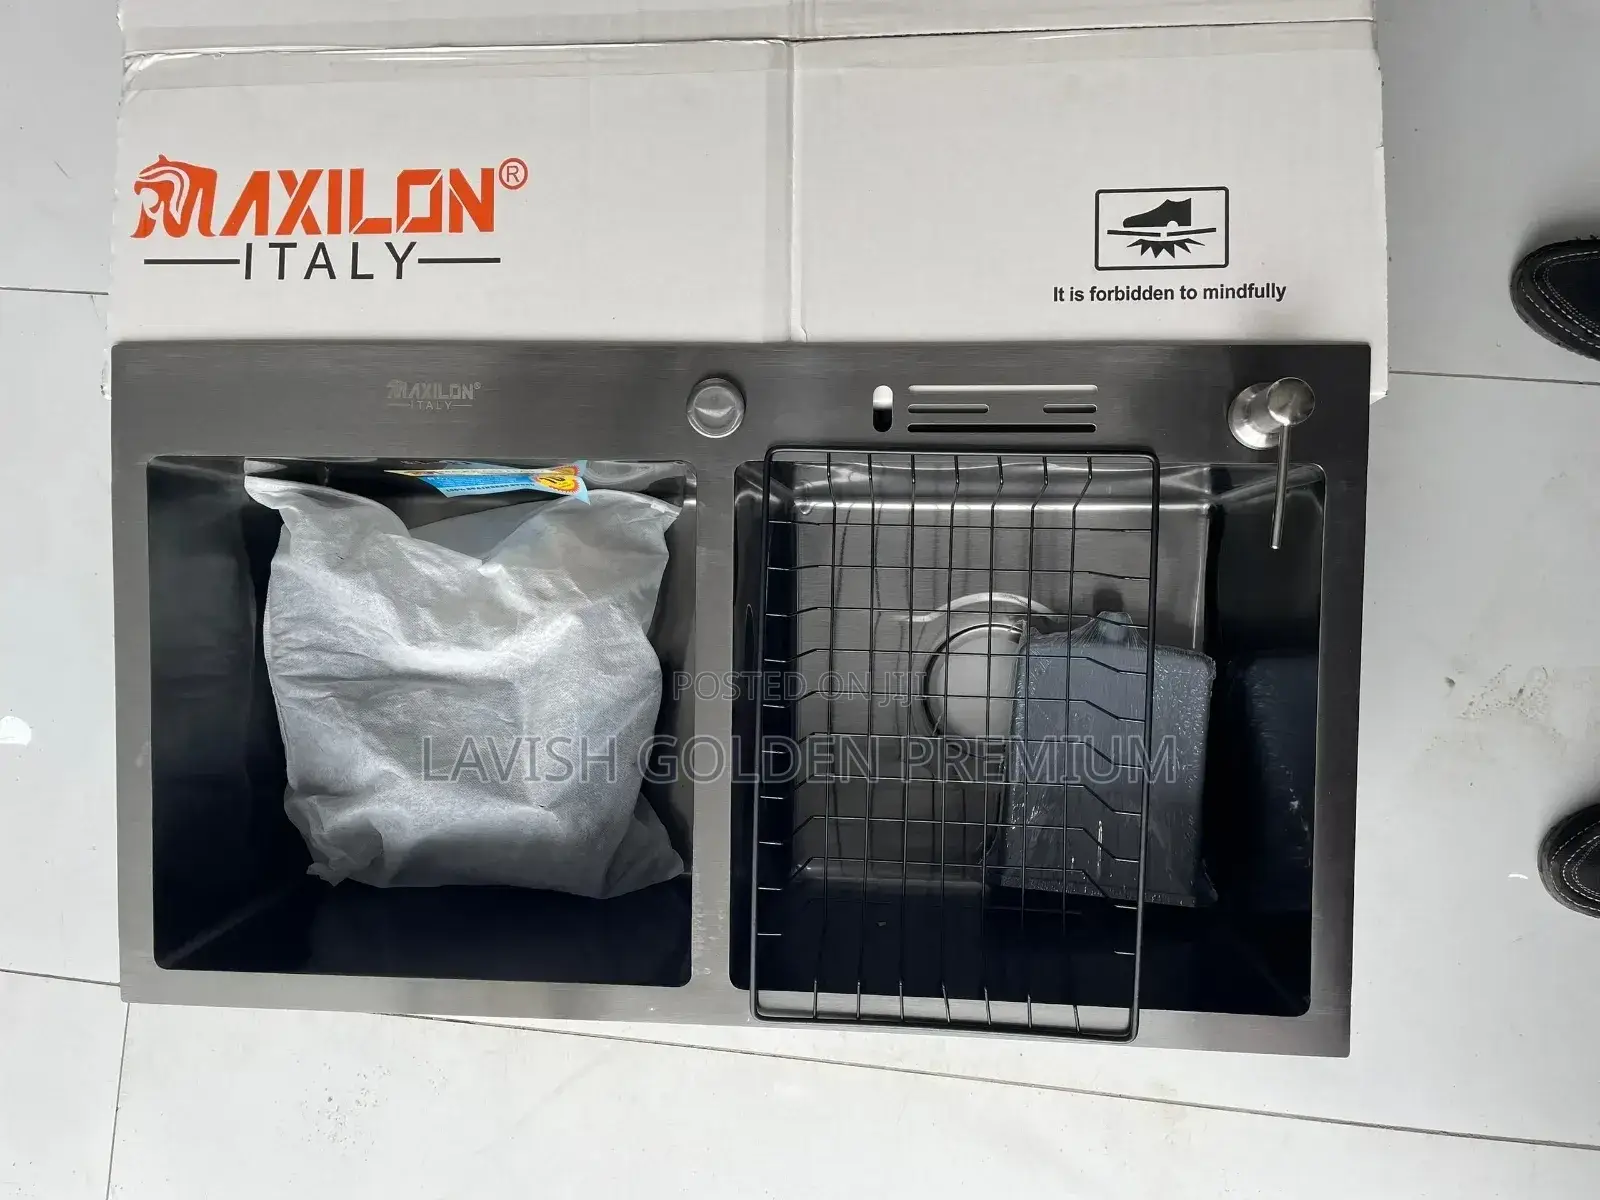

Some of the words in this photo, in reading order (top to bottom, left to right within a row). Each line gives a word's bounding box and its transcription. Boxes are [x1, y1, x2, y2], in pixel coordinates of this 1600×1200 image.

[244, 241, 417, 280] ITALY
[1053, 286, 1065, 302] It
[1070, 286, 1084, 301] is
[1089, 285, 1175, 301] forbidden
[1179, 285, 1197, 300] to
[1203, 282, 1287, 302] mindfully
[410, 401, 452, 410] ITALY
